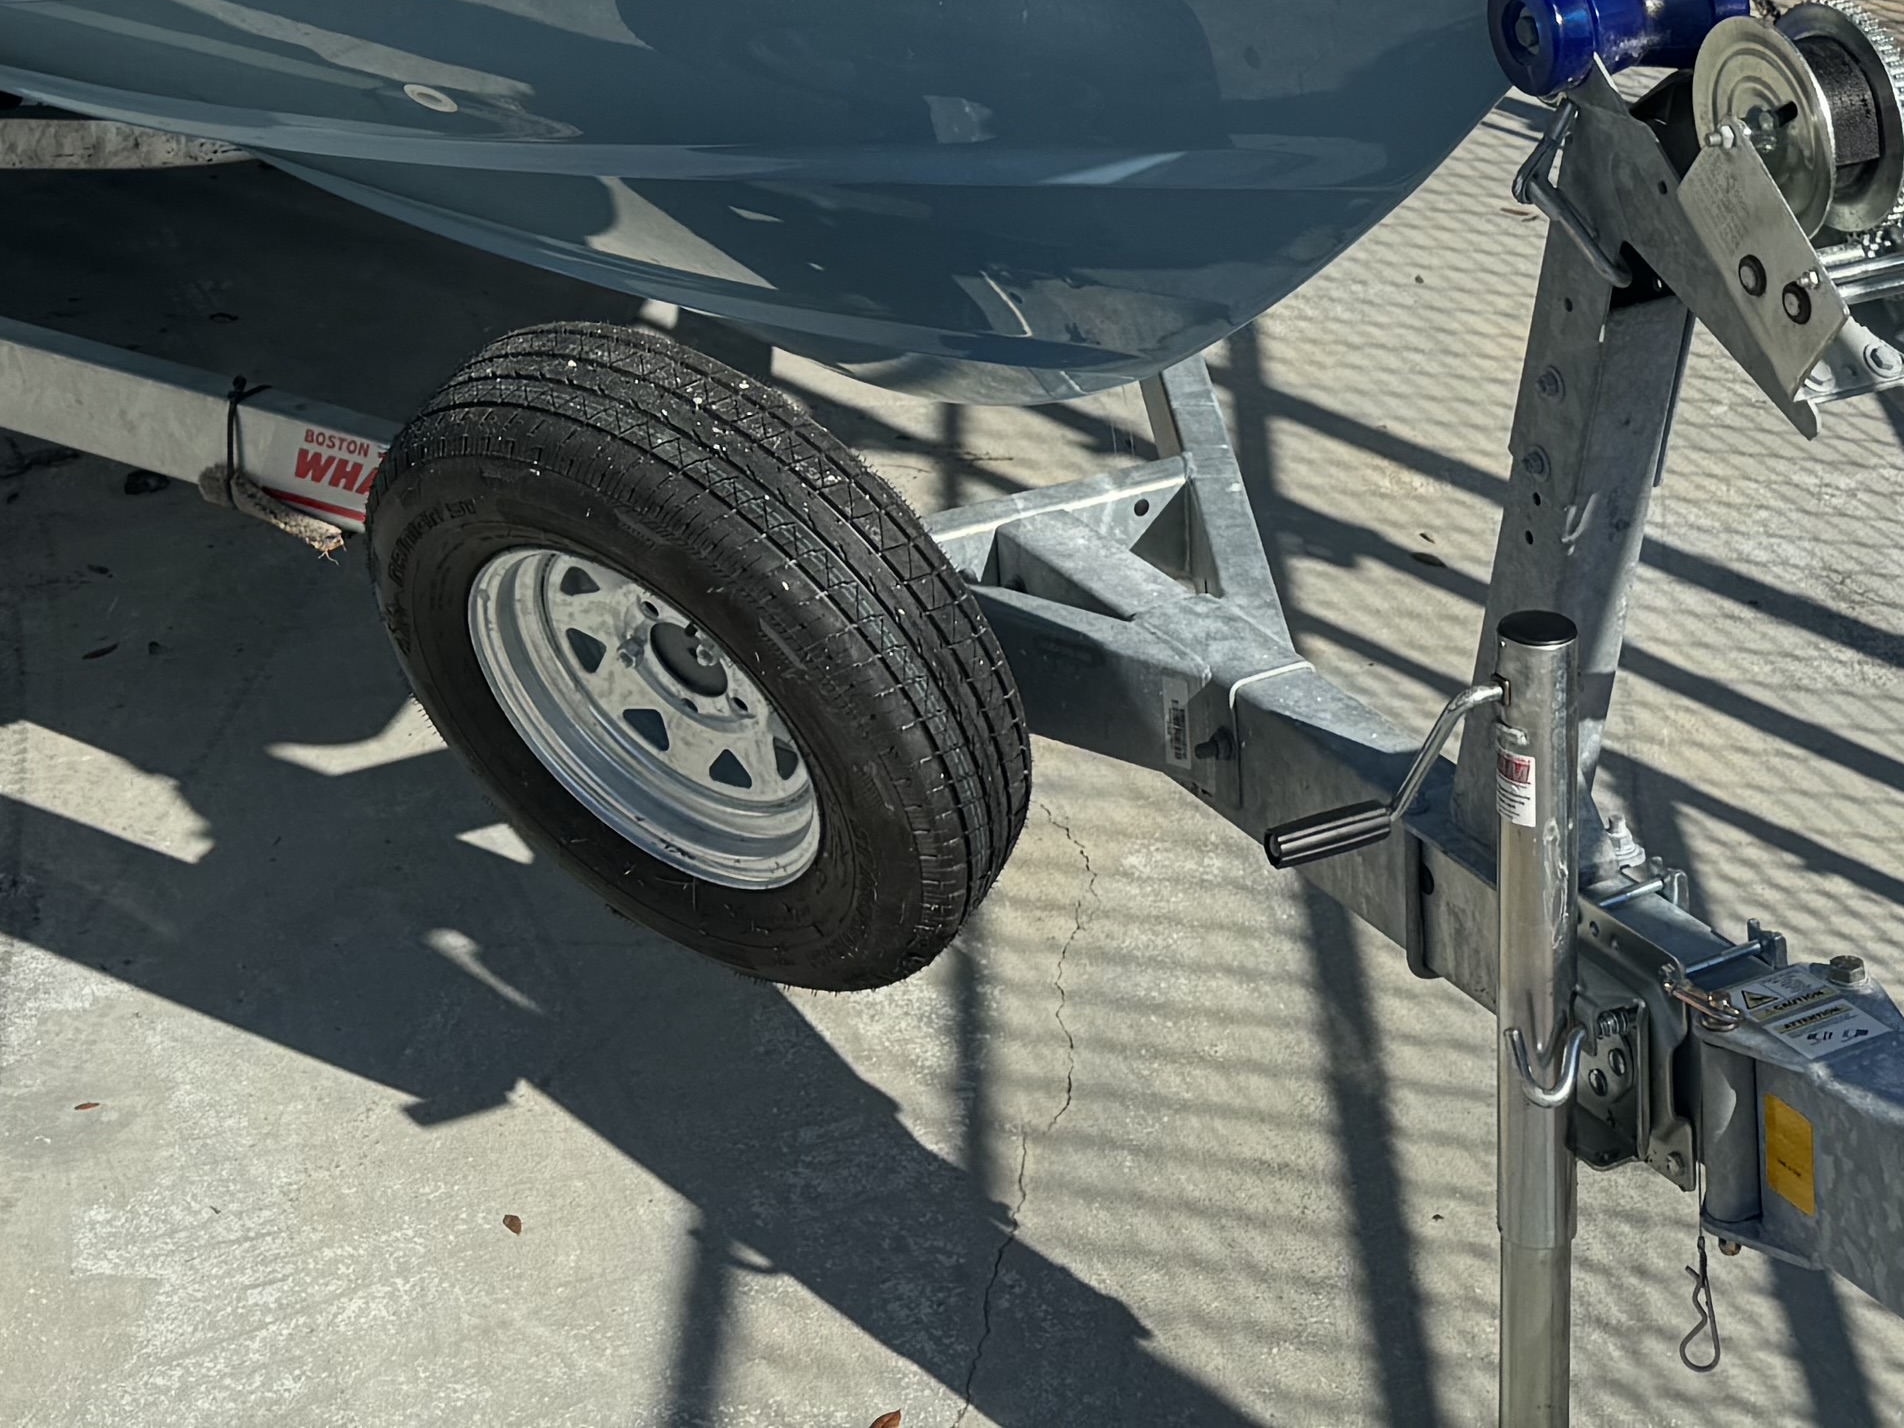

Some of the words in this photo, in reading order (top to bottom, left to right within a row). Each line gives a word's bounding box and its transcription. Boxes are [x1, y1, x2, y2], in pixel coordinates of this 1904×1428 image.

[304, 428, 370, 458] BOSTON
[1773, 989, 1824, 1011] CAUTION
[1783, 1006, 1841, 1030] ATTENTION
